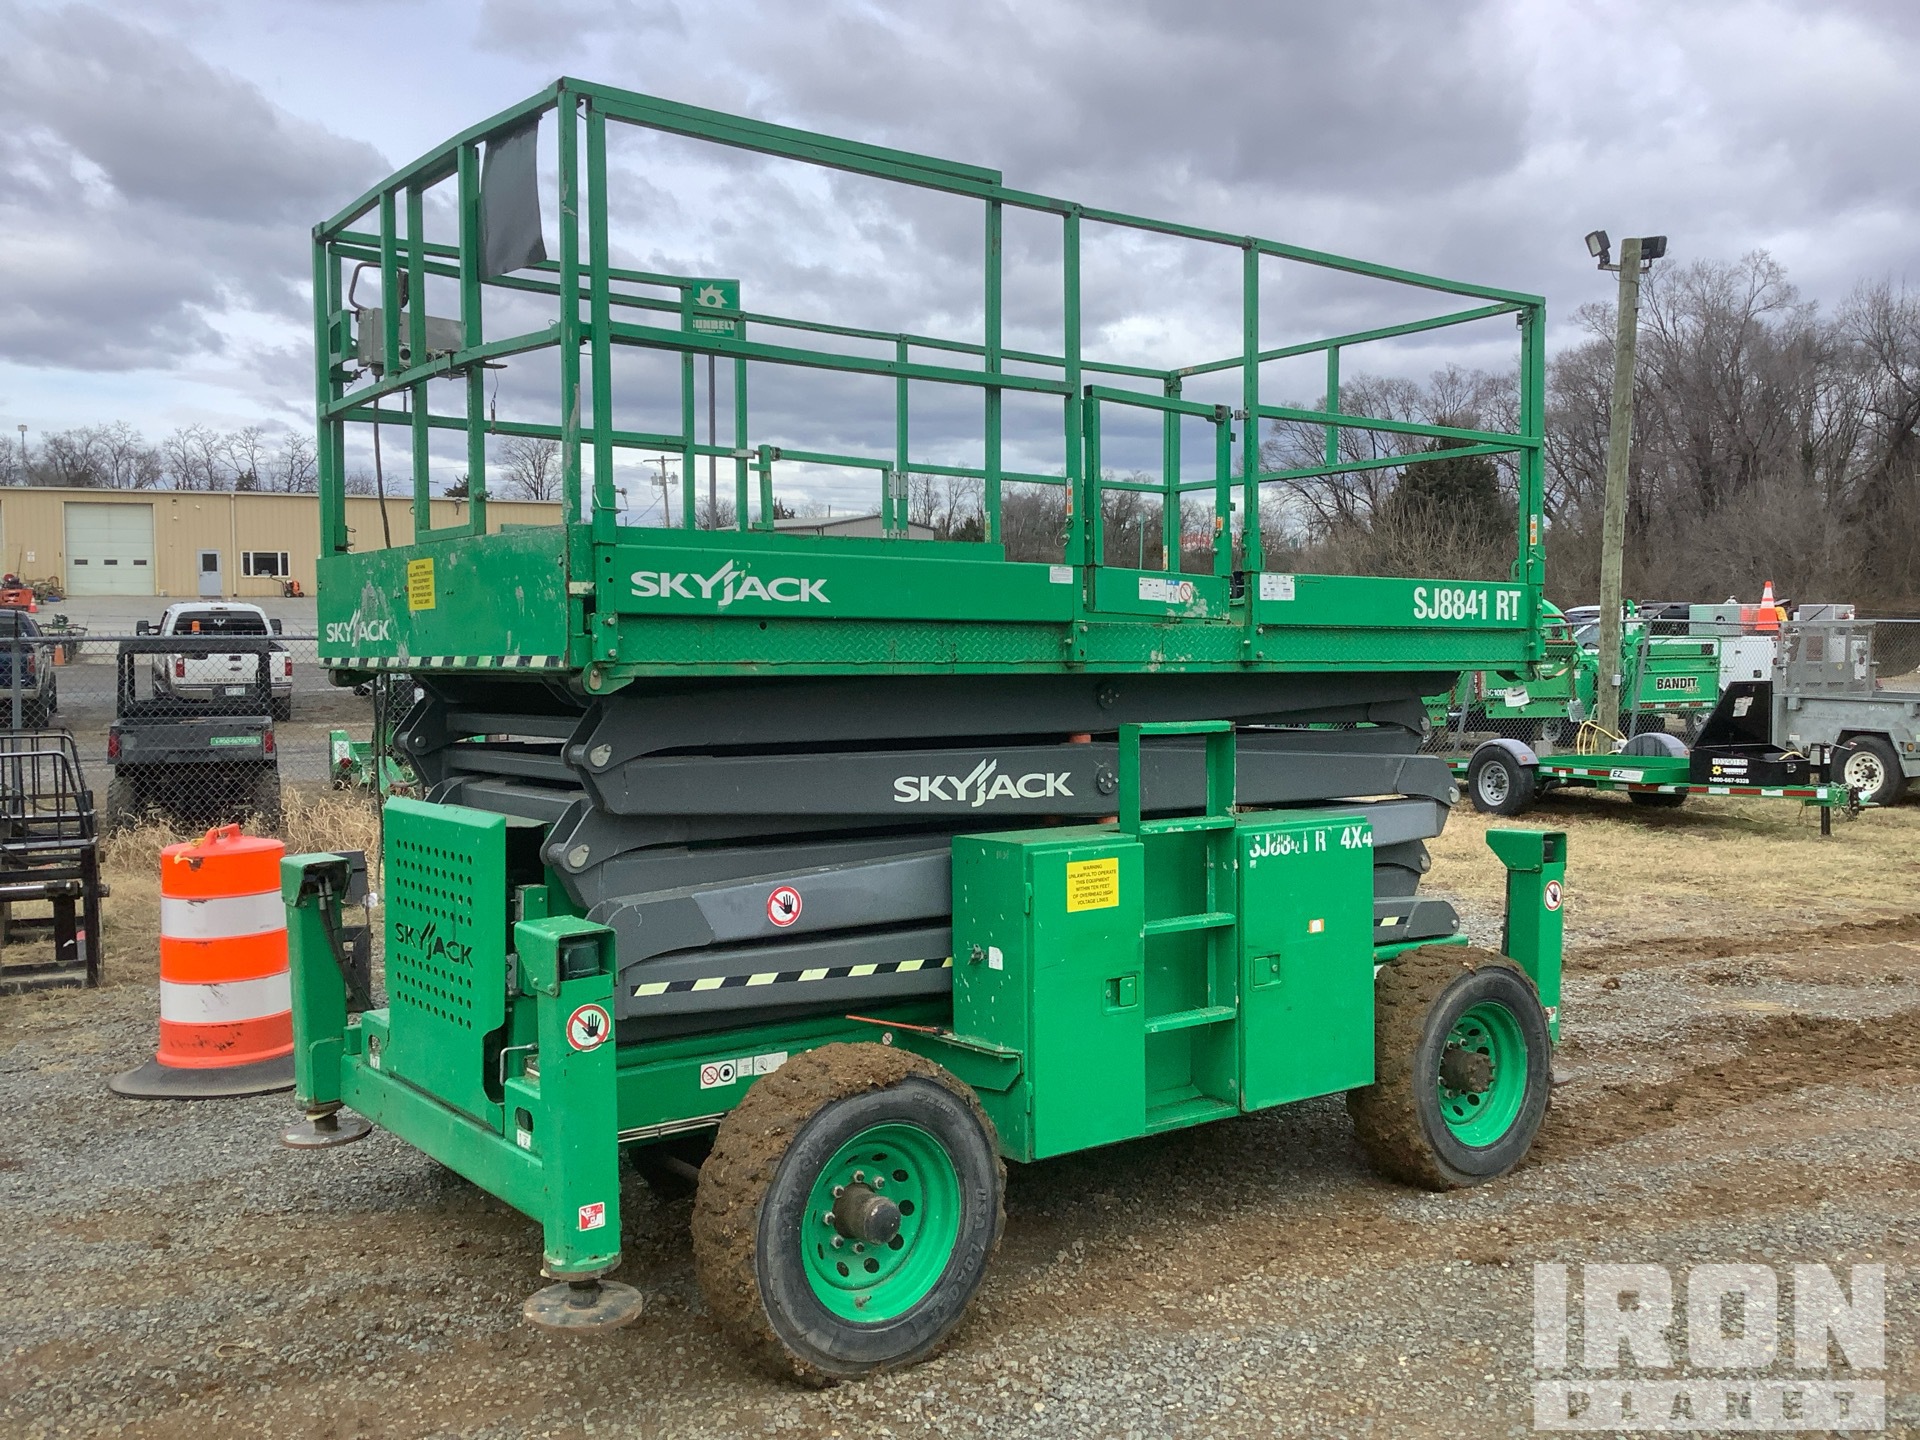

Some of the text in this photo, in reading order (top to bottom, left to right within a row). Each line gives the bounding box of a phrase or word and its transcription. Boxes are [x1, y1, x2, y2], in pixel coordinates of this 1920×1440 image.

[630, 559, 831, 606] SKYJACK
[1413, 587, 1522, 621] SJ8841 RT
[326, 609, 391, 647] SKYJACK
[1657, 677, 1698, 690] BANDIT
[893, 758, 1075, 808] SKYJACK
[1340, 825, 1373, 850] 4X4
[395, 920, 473, 969] SKYJACK
